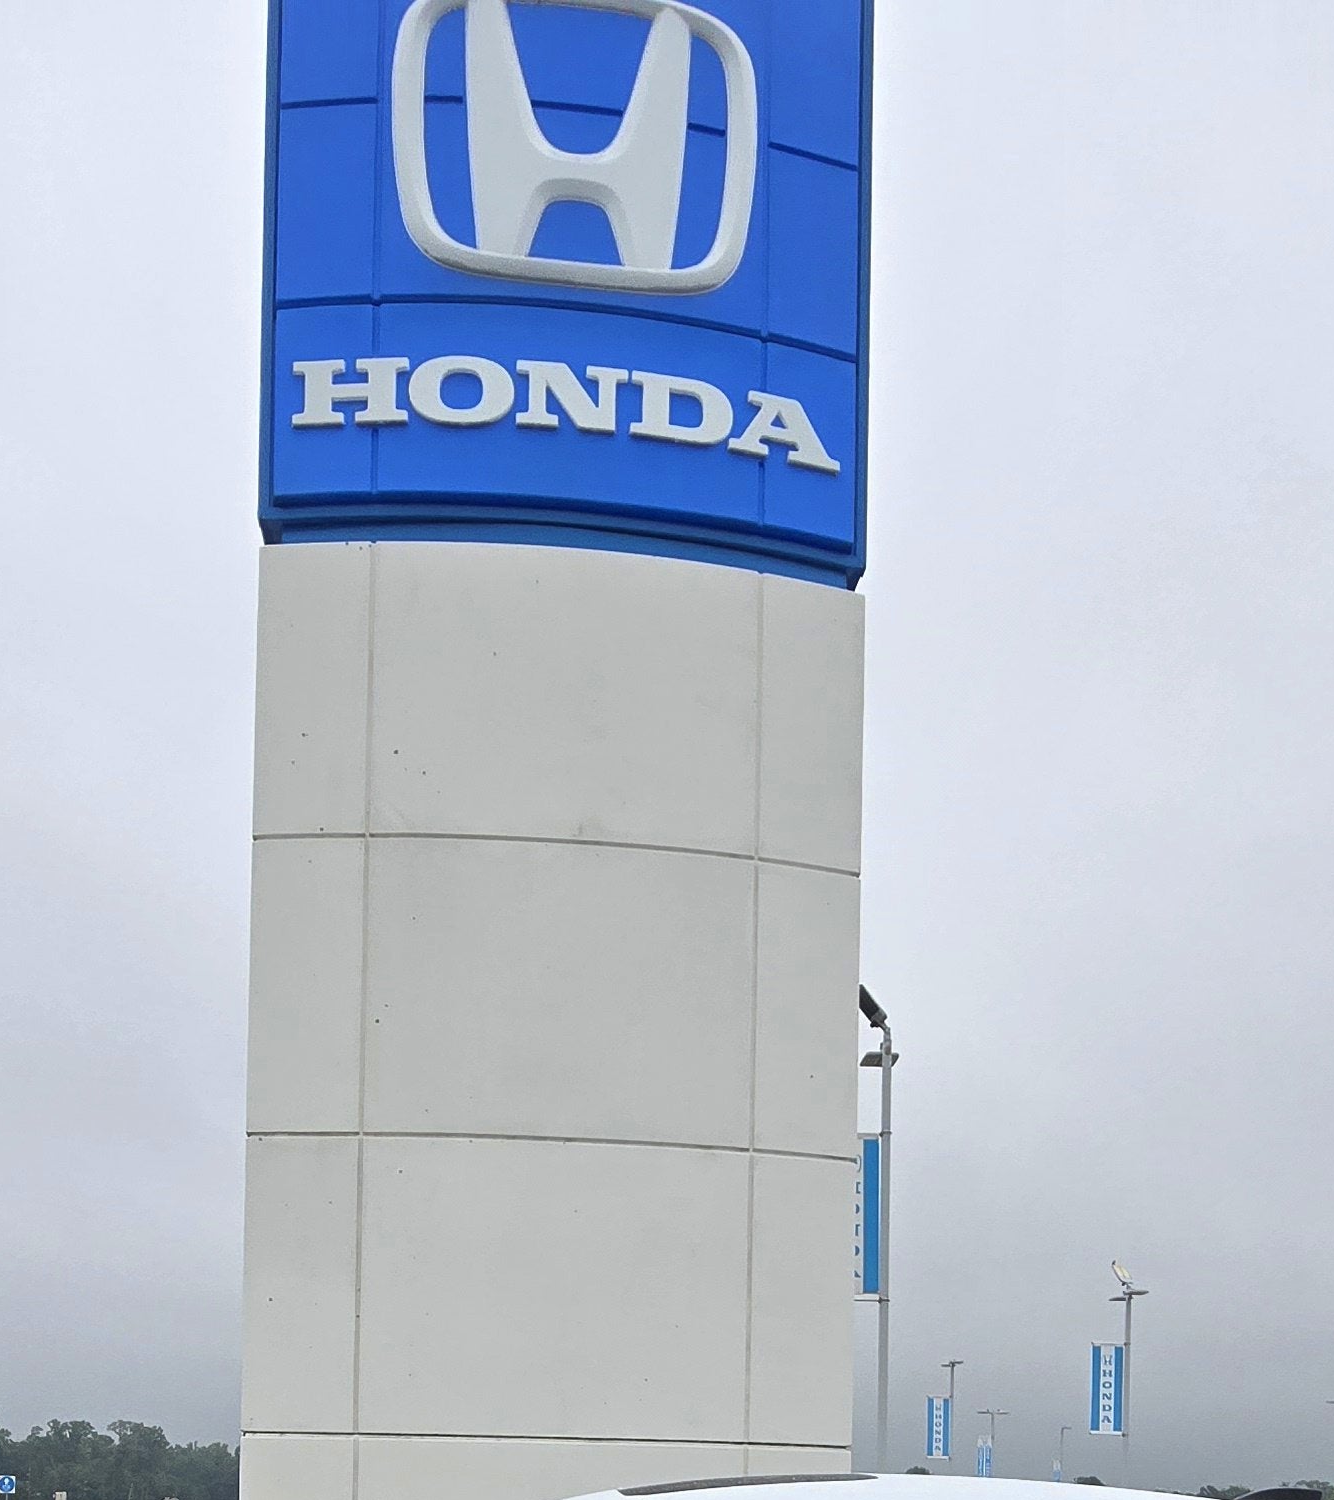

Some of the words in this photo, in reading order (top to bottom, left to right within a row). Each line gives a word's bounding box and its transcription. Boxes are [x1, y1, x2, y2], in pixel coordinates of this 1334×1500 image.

[291, 355, 841, 476] HONDA
[1102, 1370, 1113, 1424] HONDA
[934, 1413, 942, 1452] HONDA
